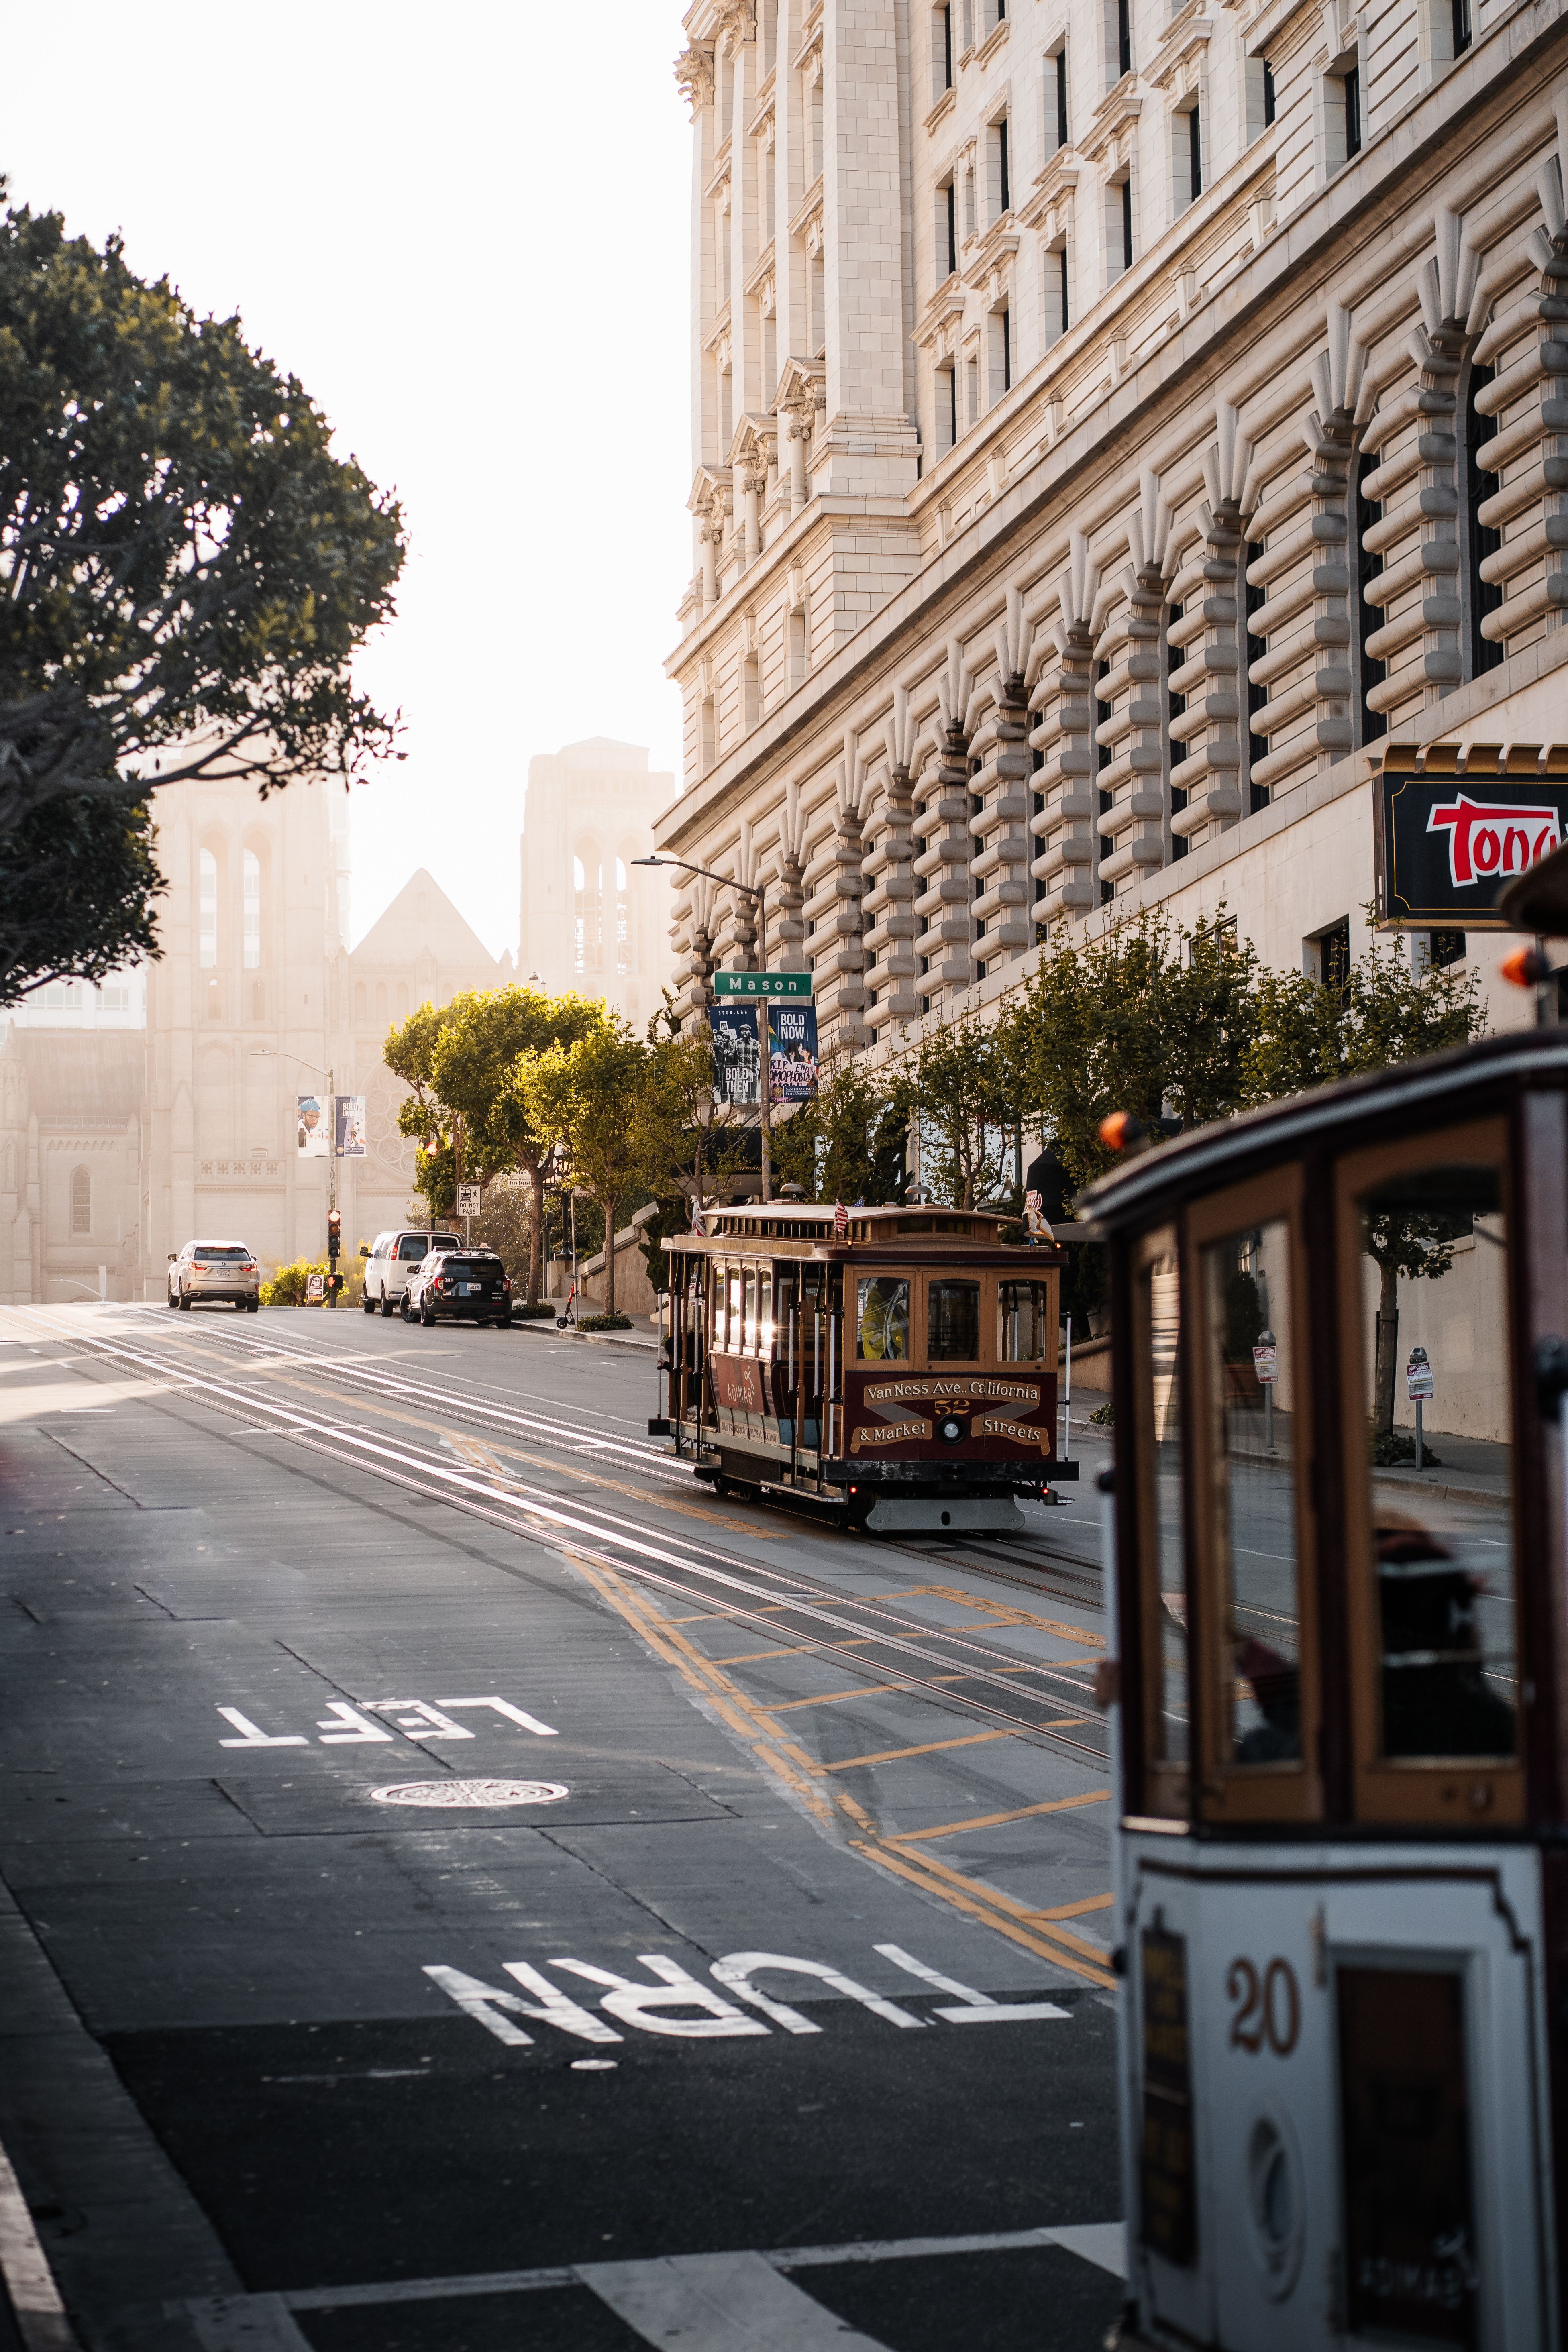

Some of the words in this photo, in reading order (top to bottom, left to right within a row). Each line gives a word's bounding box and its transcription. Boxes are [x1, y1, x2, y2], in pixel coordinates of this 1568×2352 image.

[730, 978, 797, 991] Mason
[780, 1014, 805, 1026] BOLD
[781, 1027, 804, 1039] NOW
[725, 1068, 748, 1080] BOLD
[795, 1063, 809, 1073] END
[769, 1070, 810, 1082] OMOPHOBIA
[725, 1080, 748, 1092] THEN
[343, 1102, 357, 1110] BOLD
[728, 1383, 753, 1405] ADIMAB
[868, 1387, 891, 1400] Van
[895, 1383, 928, 1397] Ness
[970, 1381, 1038, 1400] California
[934, 1400, 970, 1415] 52
[728, 1423, 745, 1435] FRNCISCO
[764, 1431, 777, 1443] AILWAY
[860, 1428, 871, 1441] &
[874, 1422, 925, 1442] Market
[984, 1419, 1041, 1441] Streets
[216, 1696, 559, 1748] LEFT
[421, 1943, 1074, 2046] TURN
[1226, 1955, 1302, 2057] 20
